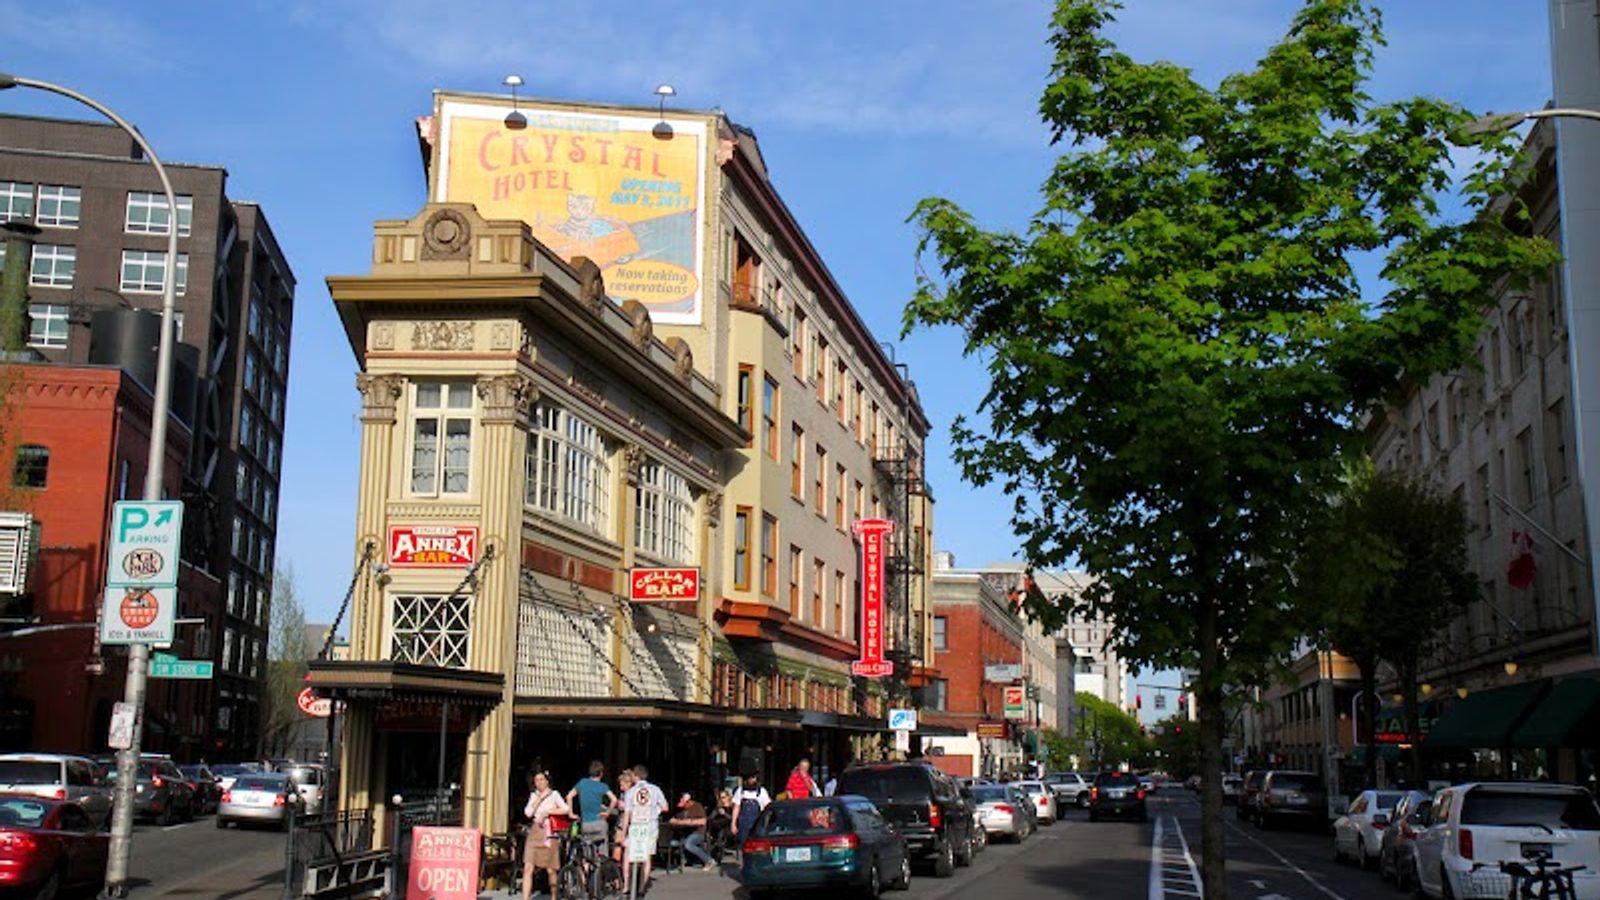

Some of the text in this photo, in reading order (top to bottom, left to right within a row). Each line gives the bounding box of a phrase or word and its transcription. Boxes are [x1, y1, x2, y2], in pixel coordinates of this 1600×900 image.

[480, 131, 666, 178] CRYSTAL
[494, 170, 573, 201] HOTEL
[616, 268, 687, 285] Now taking
[609, 282, 688, 295] reservations
[392, 534, 473, 561] ANNEX
[412, 551, 451, 562] BAR
[867, 534, 878, 602] CRYSTAL
[635, 571, 695, 590] CELLAR
[645, 584, 685, 595] BAR
[867, 609, 878, 658] HOTEL
[1375, 718, 1440, 733] JAE
[417, 833, 475, 851] ANNEX
[417, 867, 471, 893] OPEN
